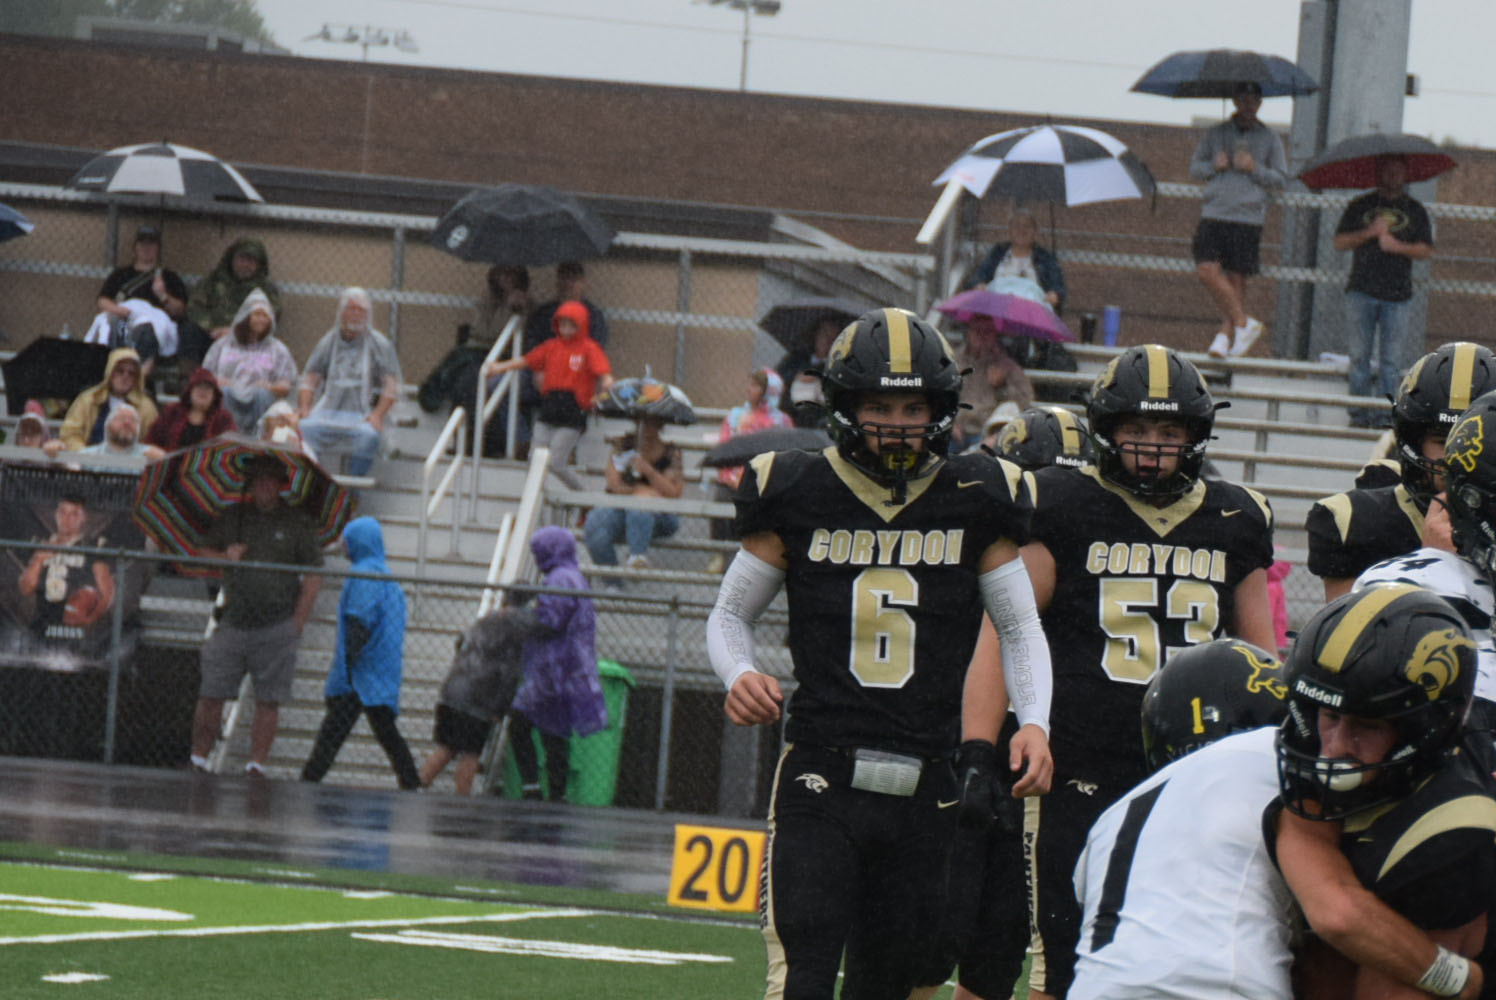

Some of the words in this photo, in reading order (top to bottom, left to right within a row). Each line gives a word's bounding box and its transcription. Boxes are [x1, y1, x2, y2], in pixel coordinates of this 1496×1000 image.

[880, 377, 923, 387] Riddell
[1140, 401, 1179, 411] Riddell
[808, 528, 964, 565] CORYDON
[1086, 541, 1227, 583] CORYDON
[849, 567, 919, 689] 6
[1099, 577, 1219, 685] 53
[1296, 680, 1343, 707] Riddell
[1190, 697, 1205, 734] 1
[678, 834, 750, 904] 20
[1091, 777, 1171, 953] 1
